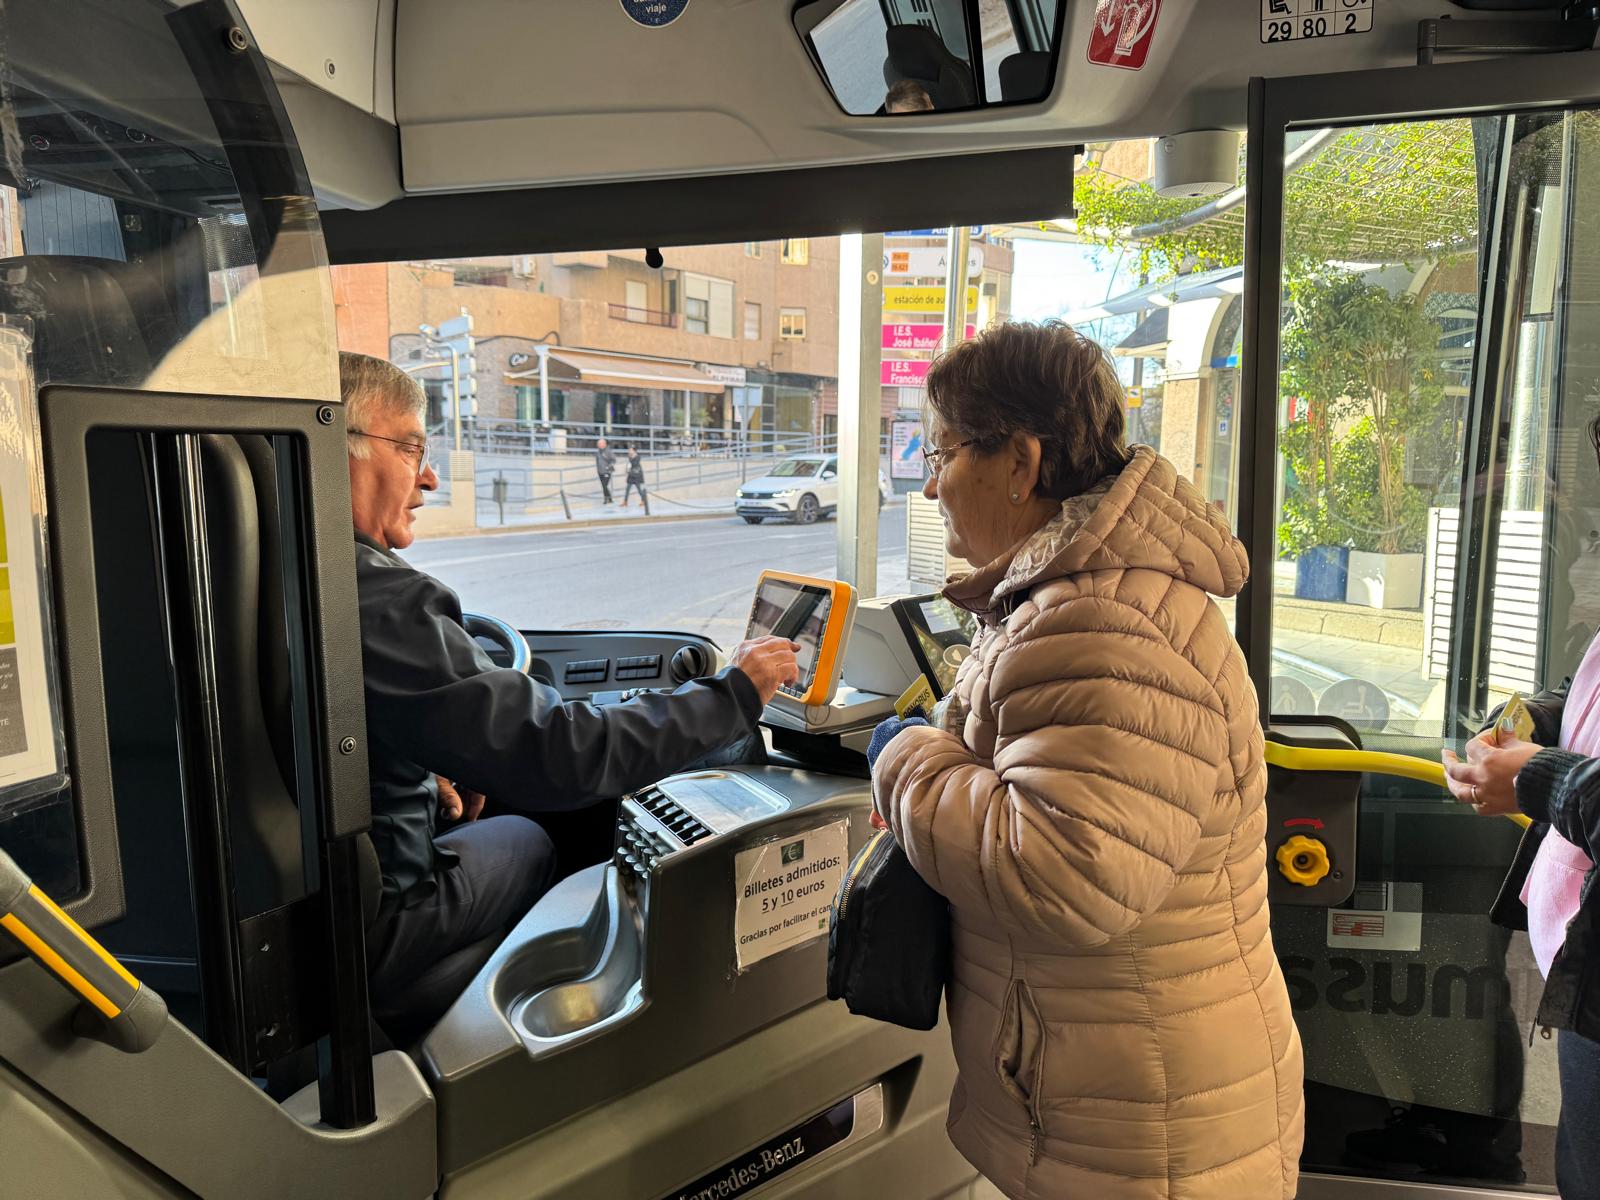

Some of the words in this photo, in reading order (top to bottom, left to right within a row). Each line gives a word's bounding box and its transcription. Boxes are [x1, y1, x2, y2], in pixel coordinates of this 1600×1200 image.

[646, 3, 667, 14] viaje
[1268, 22, 1292, 42] 29
[1302, 17, 1326, 37] 80
[1345, 13, 1357, 33] 2
[894, 295, 924, 305] estación
[925, 295, 935, 305] de
[893, 336, 912, 348] José
[890, 373, 927, 385] Francisc
[744, 875, 784, 899] Billetes
[786, 855, 841, 883] admitidos:
[762, 898, 770, 912] 5
[771, 896, 779, 911] y
[780, 889, 795, 904] 10
[796, 879, 826, 898] euros
[740, 927, 768, 945] Gracias
[769, 923, 782, 936] por
[783, 910, 810, 929] facilitar
[811, 907, 818, 917] el
[819, 904, 833, 914] cam
[678, 1136, 806, 1200] rcedes-Benz
